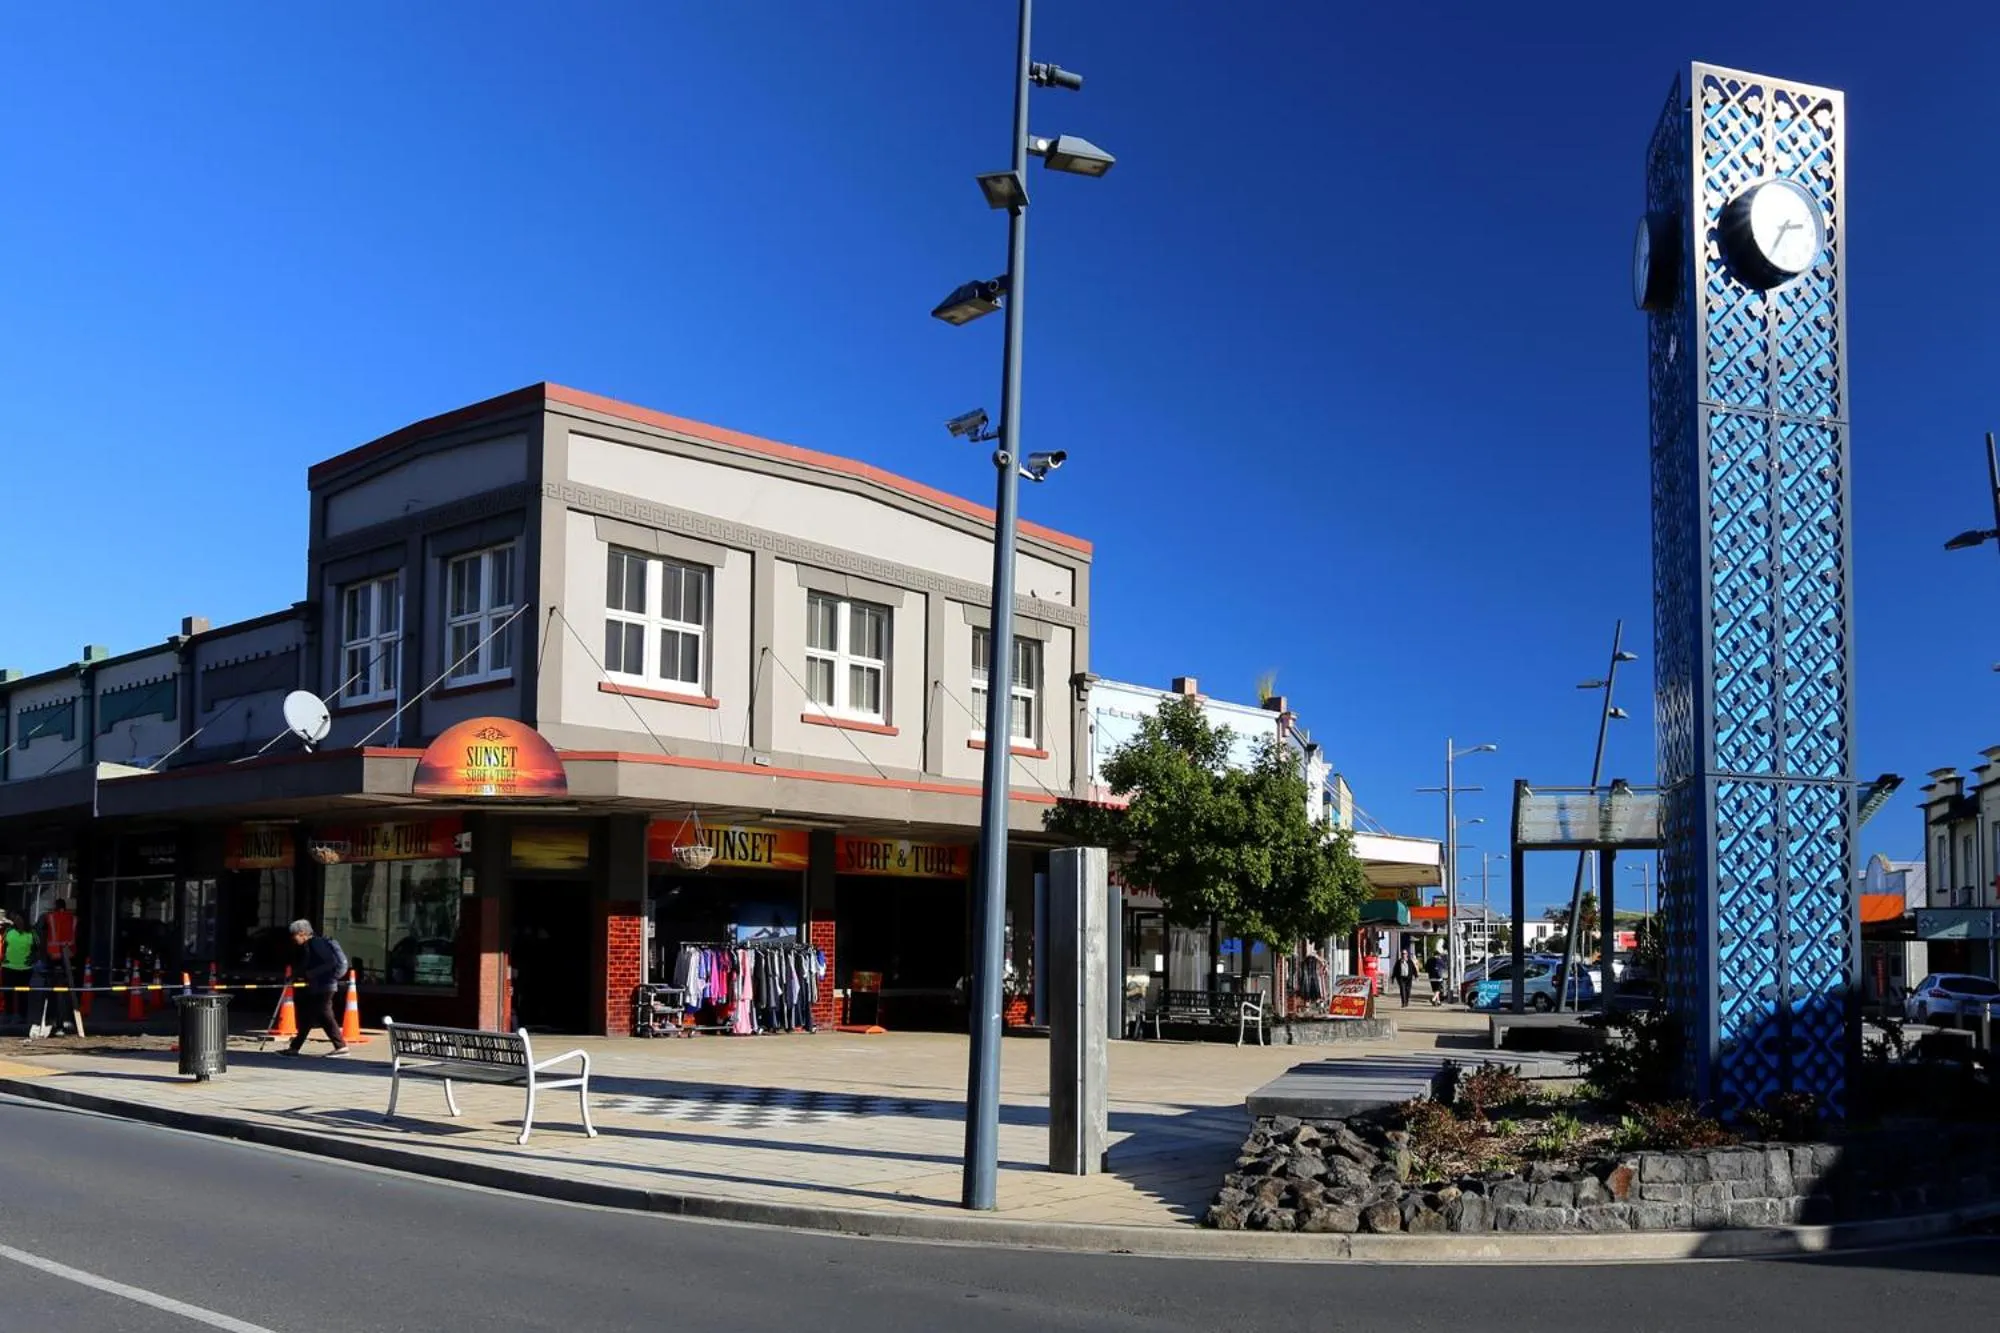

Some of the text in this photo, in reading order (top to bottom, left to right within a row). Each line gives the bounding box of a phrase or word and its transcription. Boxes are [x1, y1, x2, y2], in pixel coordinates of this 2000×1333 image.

[466, 746, 518, 767] SUNSET
[465, 769, 488, 782] SURF
[495, 769, 518, 782] TURF
[382, 831, 390, 851] &
[394, 823, 432, 855] TURF
[845, 840, 958, 874] SURF & TURF
